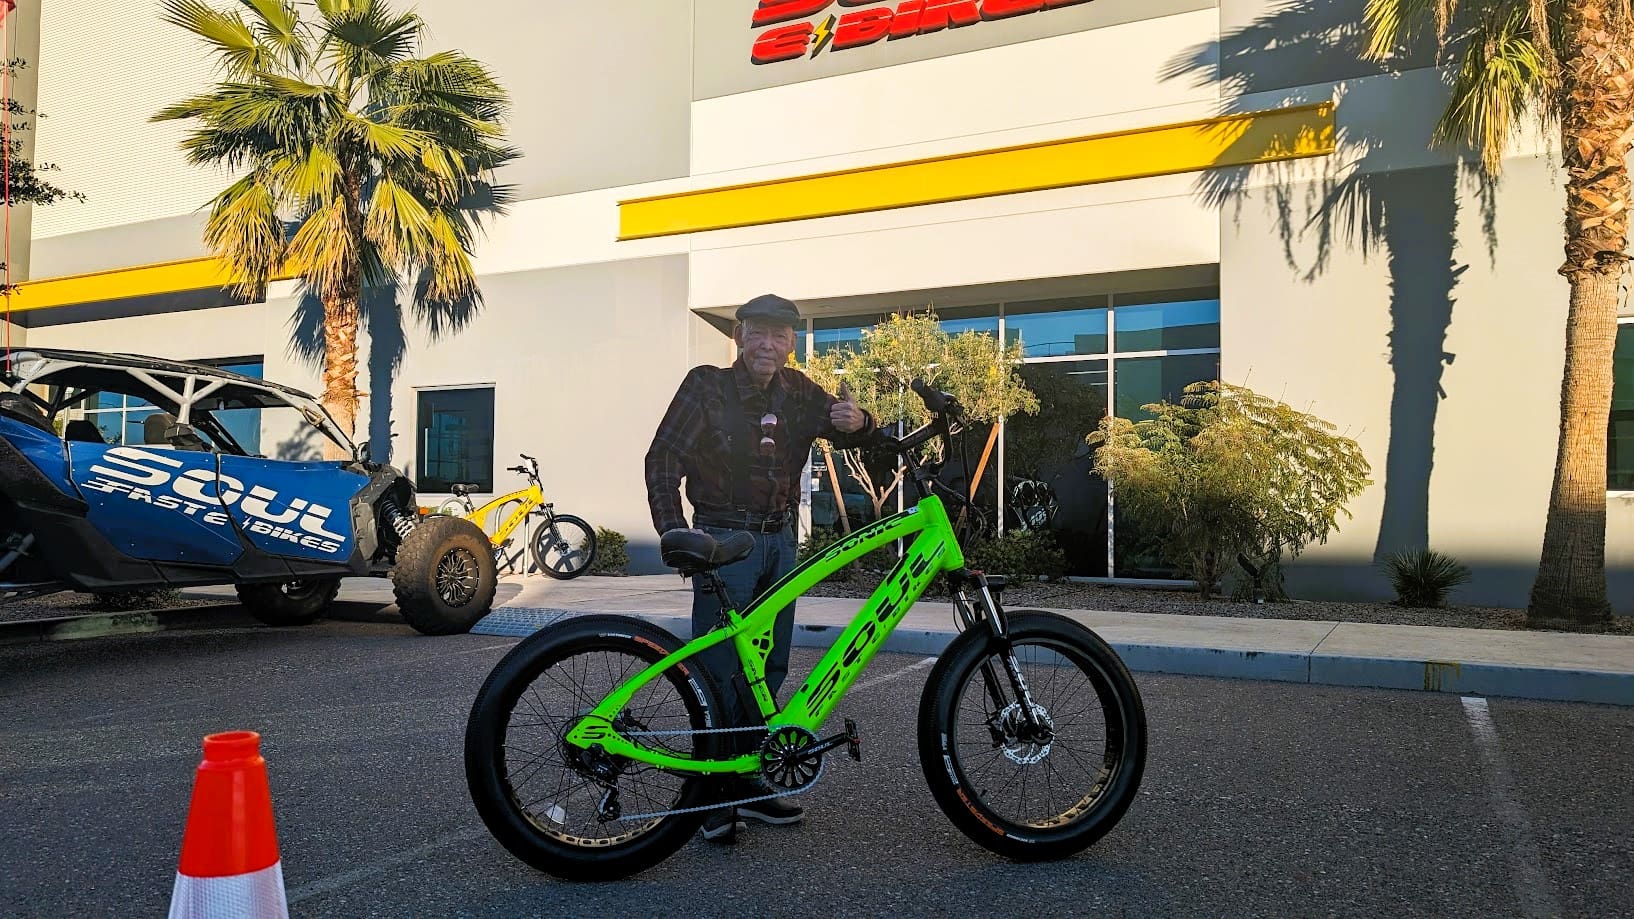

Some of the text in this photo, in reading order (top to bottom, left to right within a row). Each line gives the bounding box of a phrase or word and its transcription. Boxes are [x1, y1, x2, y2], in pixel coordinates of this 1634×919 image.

[81, 477, 208, 522] FAST
[250, 519, 341, 554] BIKES
[90, 447, 346, 542] SOUL
[824, 515, 903, 562] SONIC
[806, 540, 945, 718] SOUL
